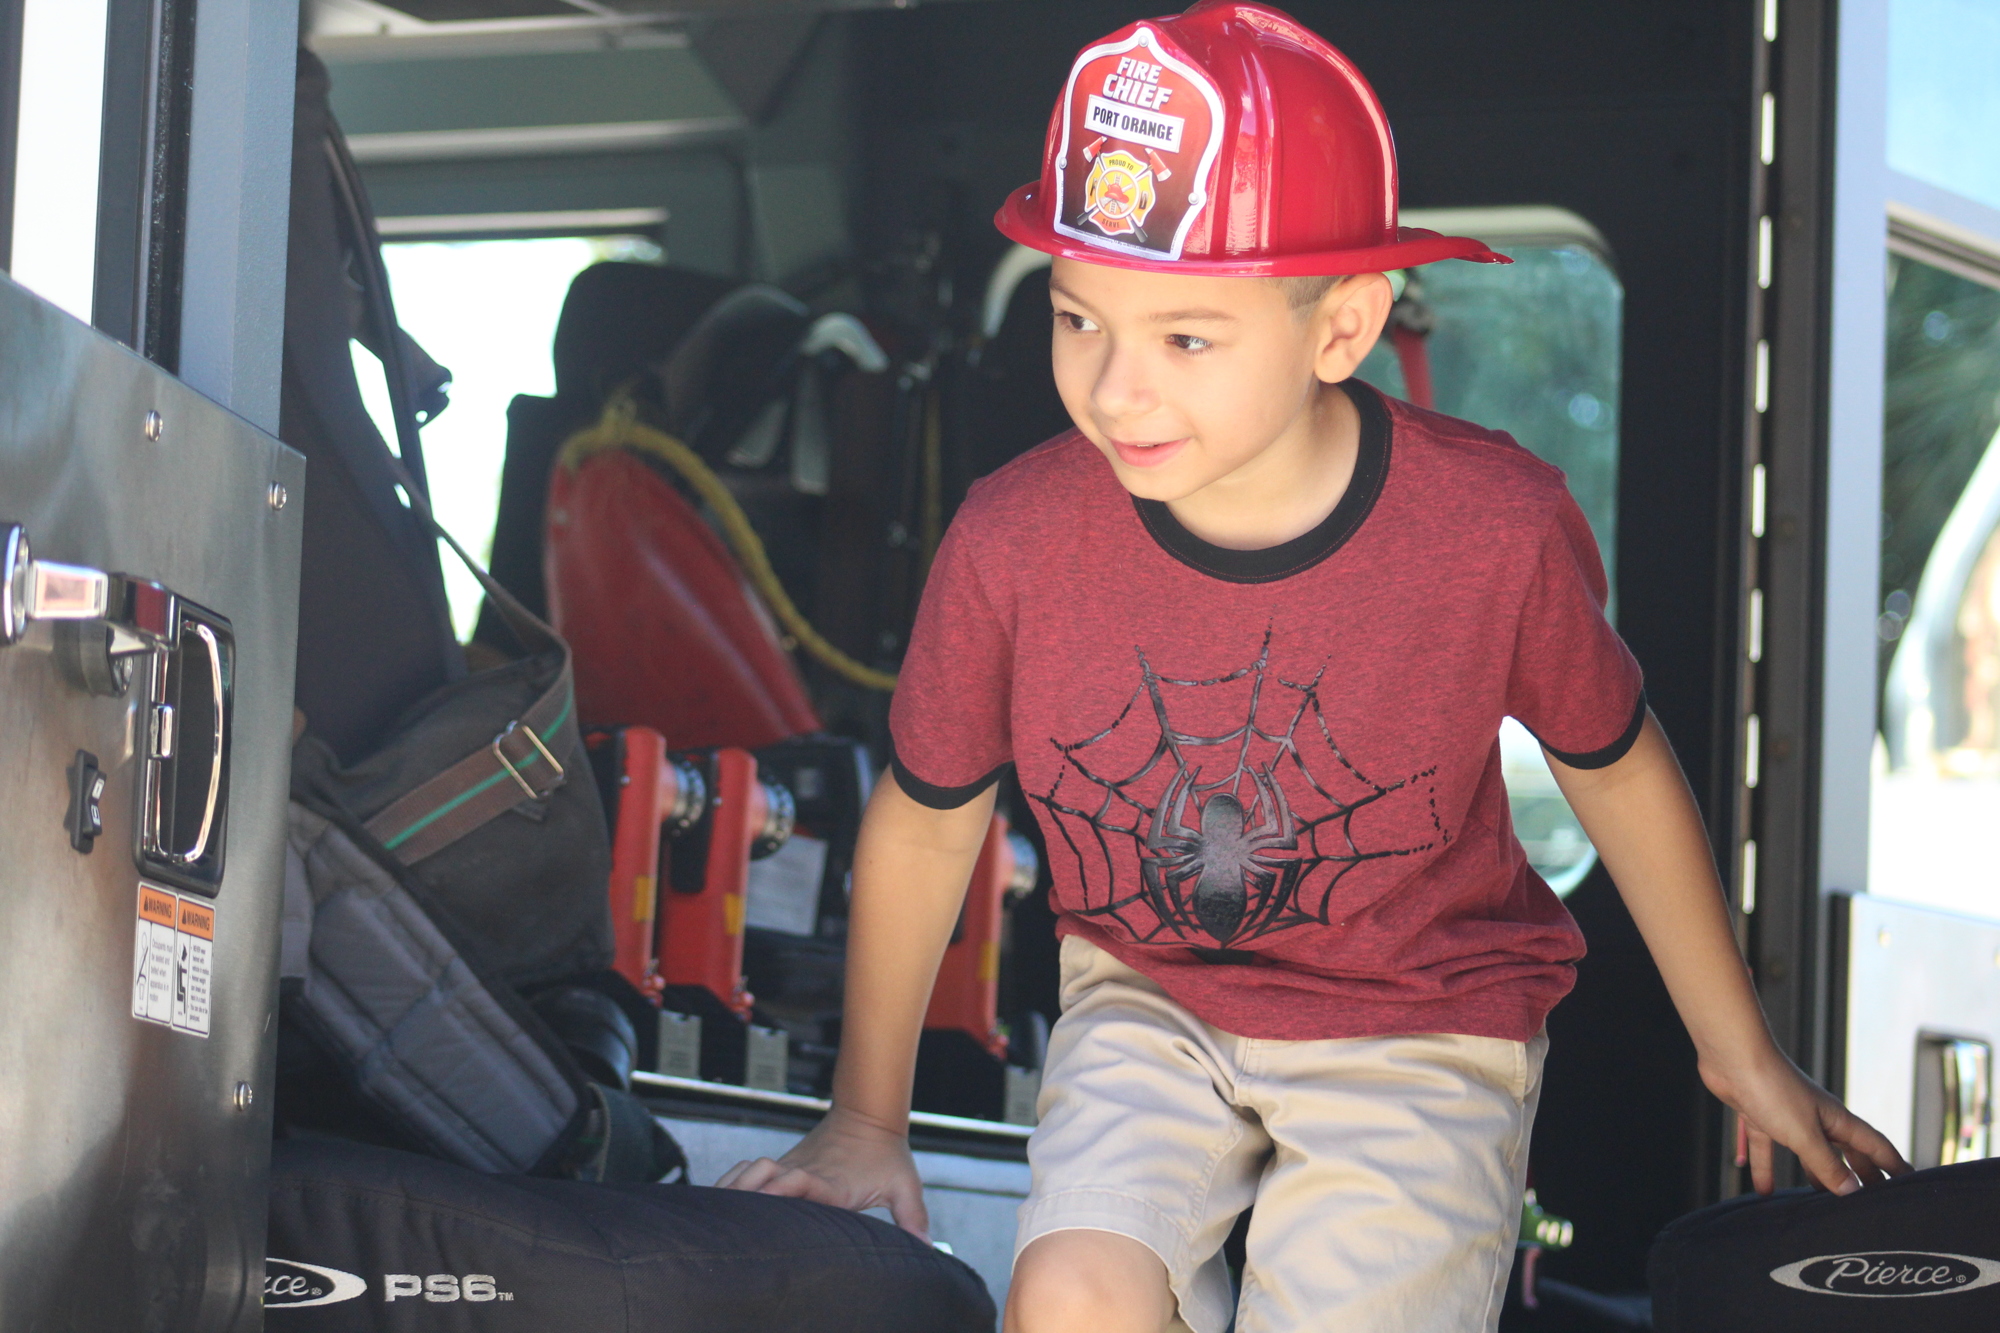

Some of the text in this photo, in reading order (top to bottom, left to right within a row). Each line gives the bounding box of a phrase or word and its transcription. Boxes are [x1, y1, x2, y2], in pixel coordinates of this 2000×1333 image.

[1117, 57, 1162, 84] FIRE
[1102, 74, 1173, 111] CHIEF
[1092, 106, 1174, 142] PORT ORANGE
[1108, 159, 1134, 171] PROUD TO
[1101, 218, 1120, 228] SERVE
[148, 897, 172, 919] WARNING
[186, 909, 210, 931] WARNING
